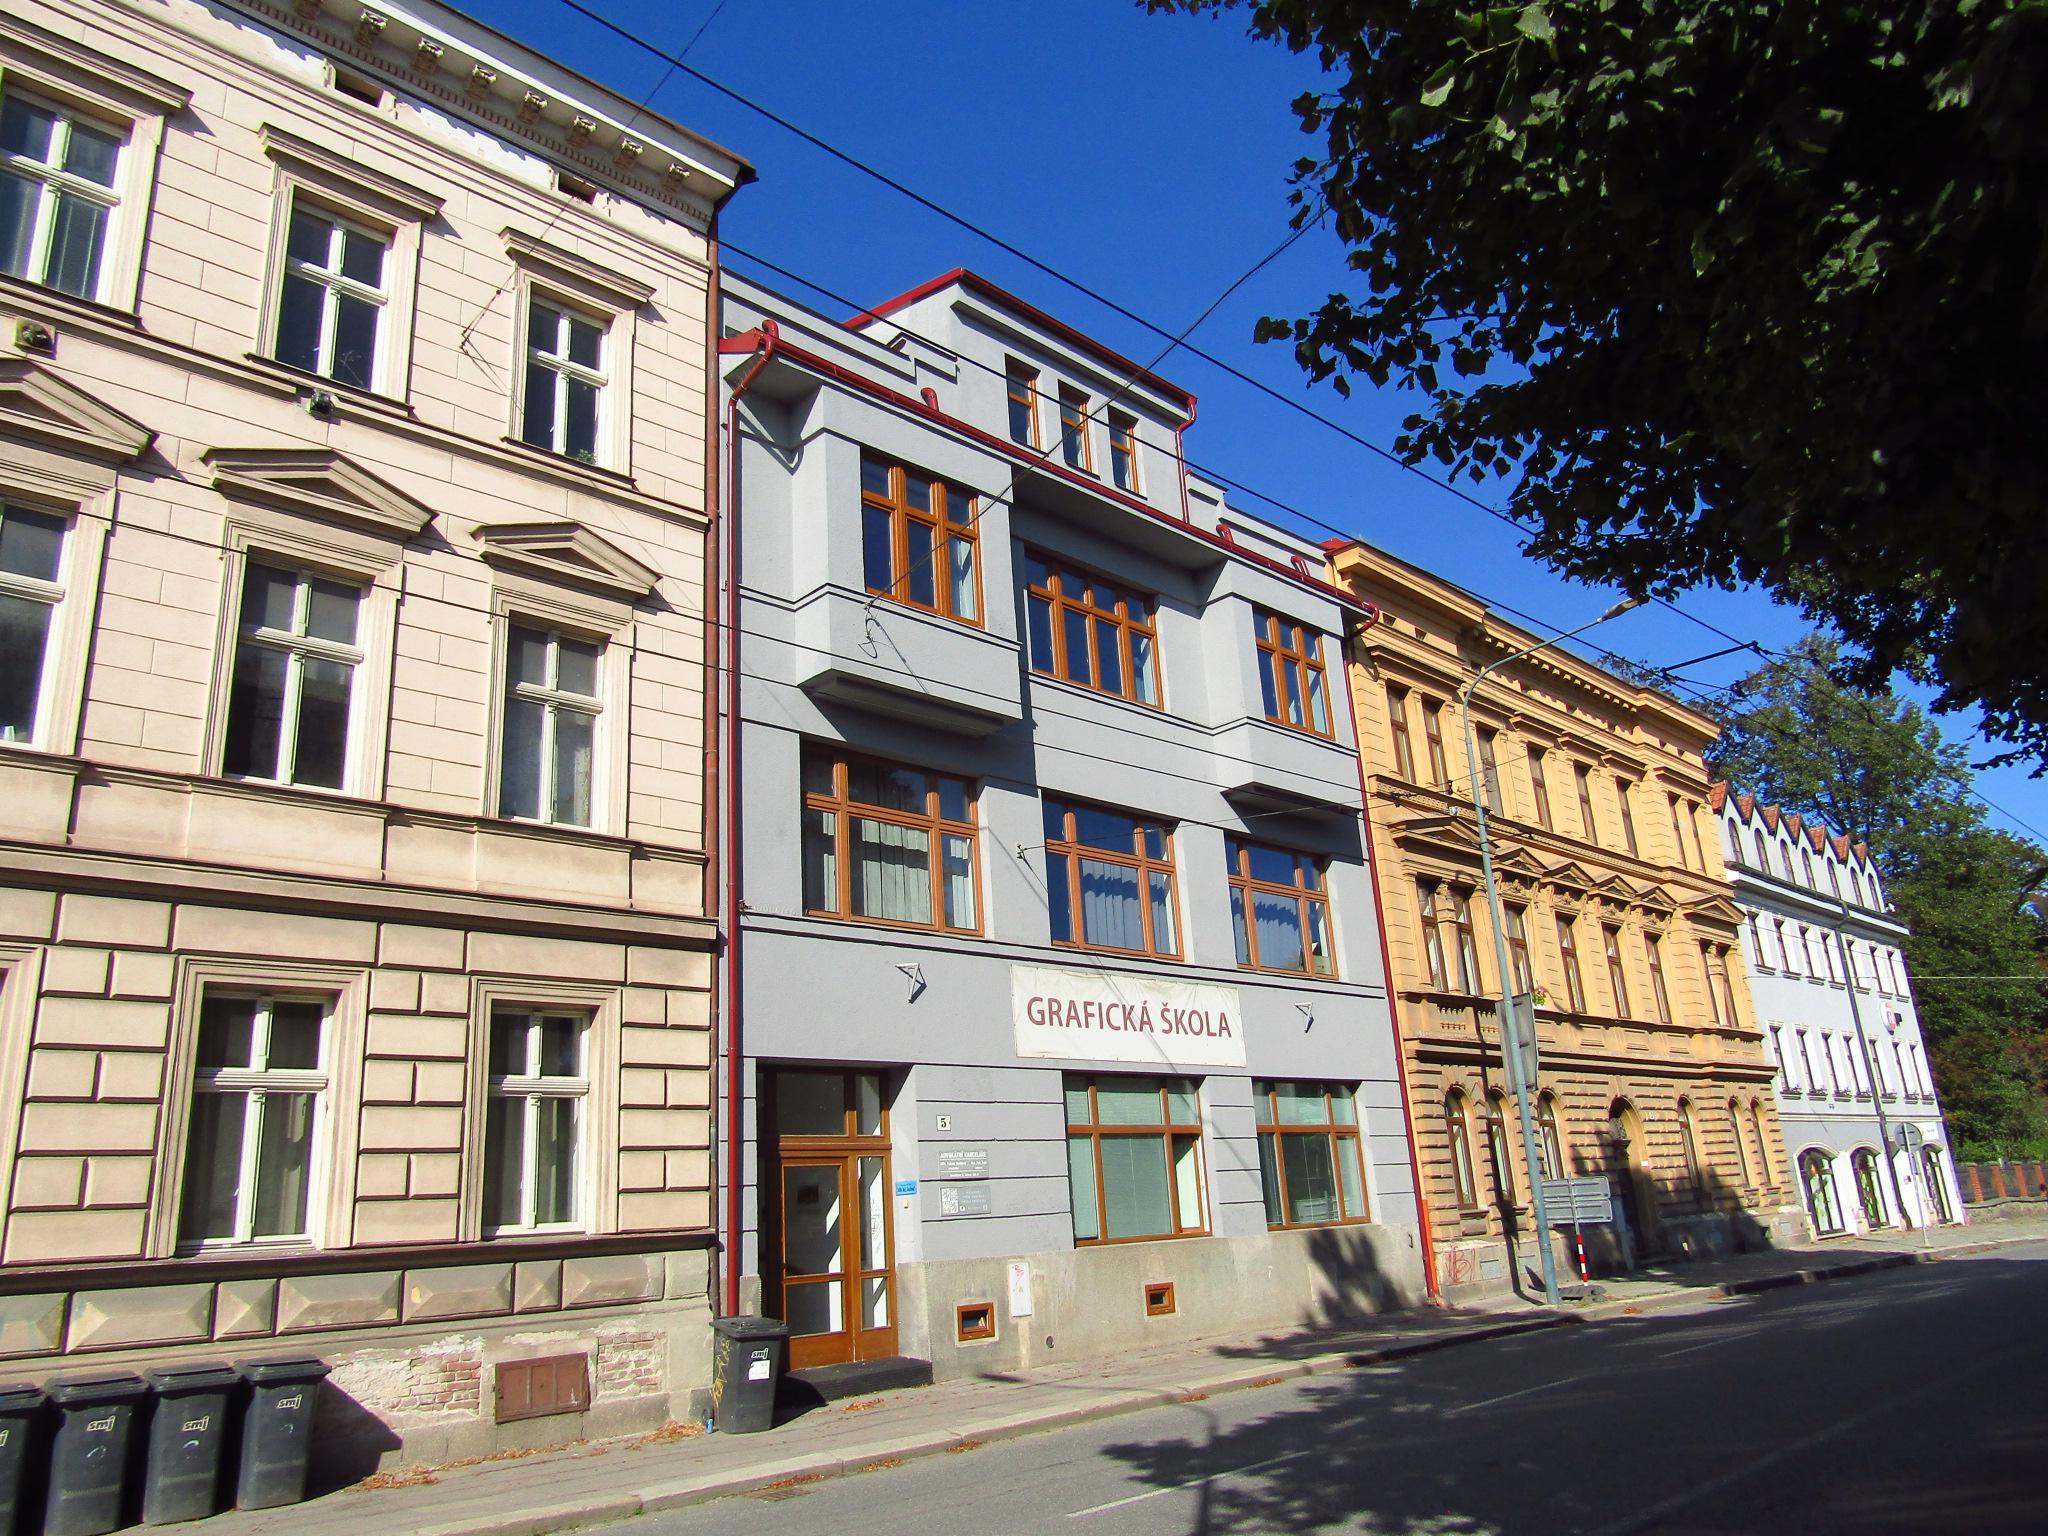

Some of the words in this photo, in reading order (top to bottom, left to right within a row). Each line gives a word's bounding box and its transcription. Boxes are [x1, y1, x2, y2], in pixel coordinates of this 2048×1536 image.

[1027, 996, 1154, 1033] GRAFICKÁ
[1160, 1002, 1232, 1038] ŠKOLA
[940, 1117, 947, 1128] 5
[751, 1347, 768, 1360] smj
[277, 1394, 303, 1409] smj
[86, 1415, 116, 1432] smj
[181, 1415, 209, 1432] smj
